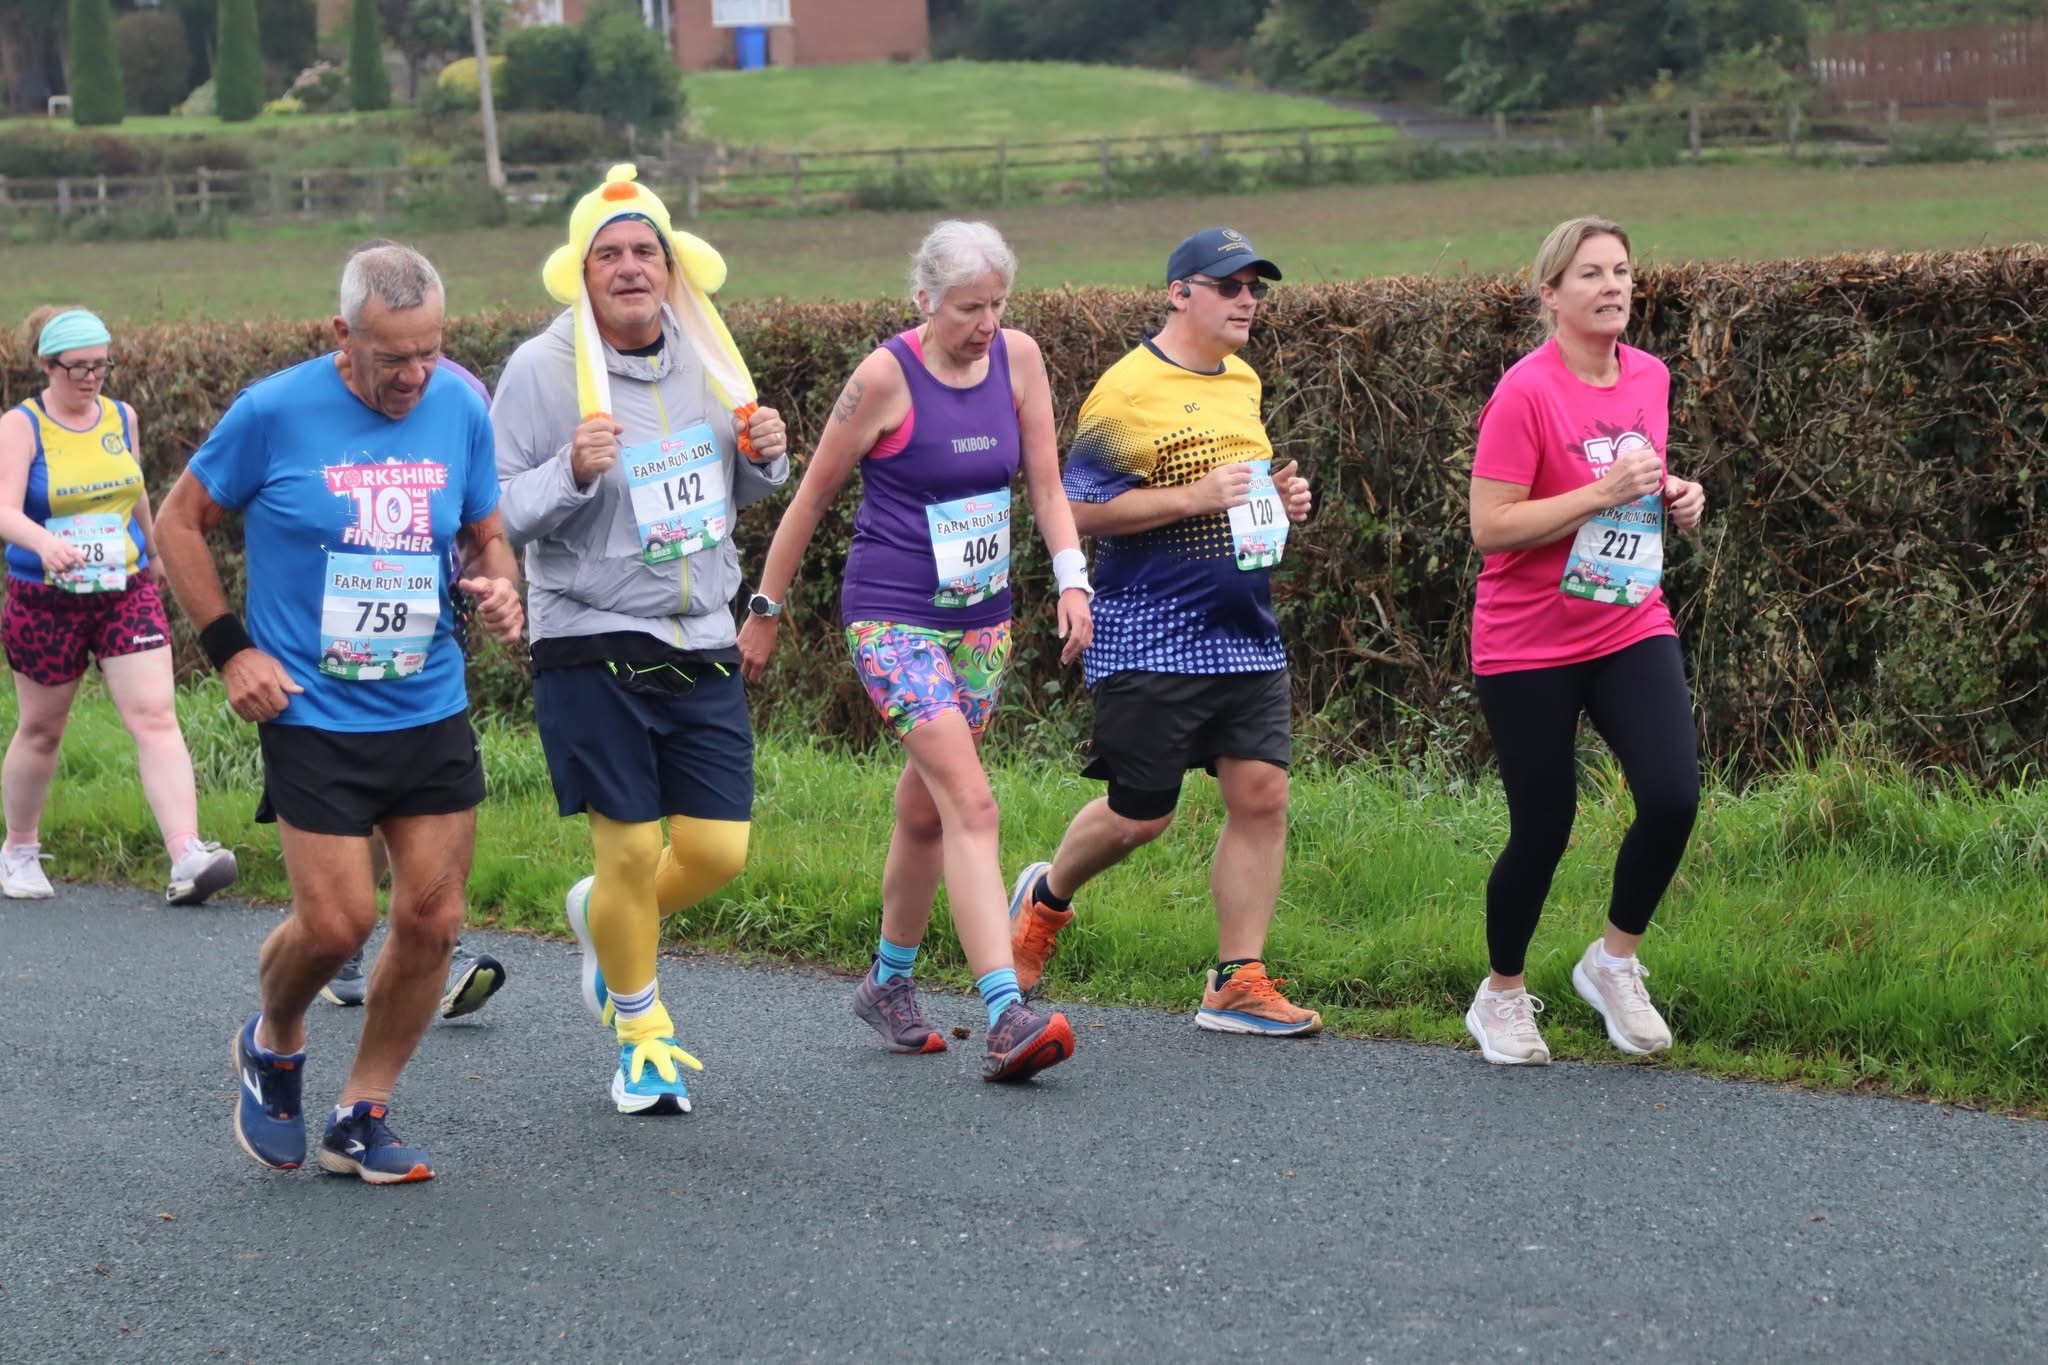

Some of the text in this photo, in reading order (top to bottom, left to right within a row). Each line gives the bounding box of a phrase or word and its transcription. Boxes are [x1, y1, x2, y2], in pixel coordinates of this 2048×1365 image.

[1184, 402, 1200, 414] DC
[952, 435, 990, 454] TIKIBOO
[633, 442, 714, 478] FARM RUN 10K
[330, 468, 445, 487] YORKSHIRE
[663, 473, 705, 511] 142
[352, 487, 412, 534] 10
[413, 488, 429, 534] MILE
[936, 508, 1009, 535] FARM RUN 10
[1249, 498, 1273, 526] 120
[1598, 507, 1658, 525] ARM RUN 10K
[74, 542, 104, 562] 28
[343, 527, 433, 552] FINISHER
[963, 533, 999, 567] 406
[1599, 530, 1641, 561] 227
[334, 574, 432, 590] FARM RUN 10K
[355, 601, 408, 633] 758
[327, 664, 348, 675] 2025
